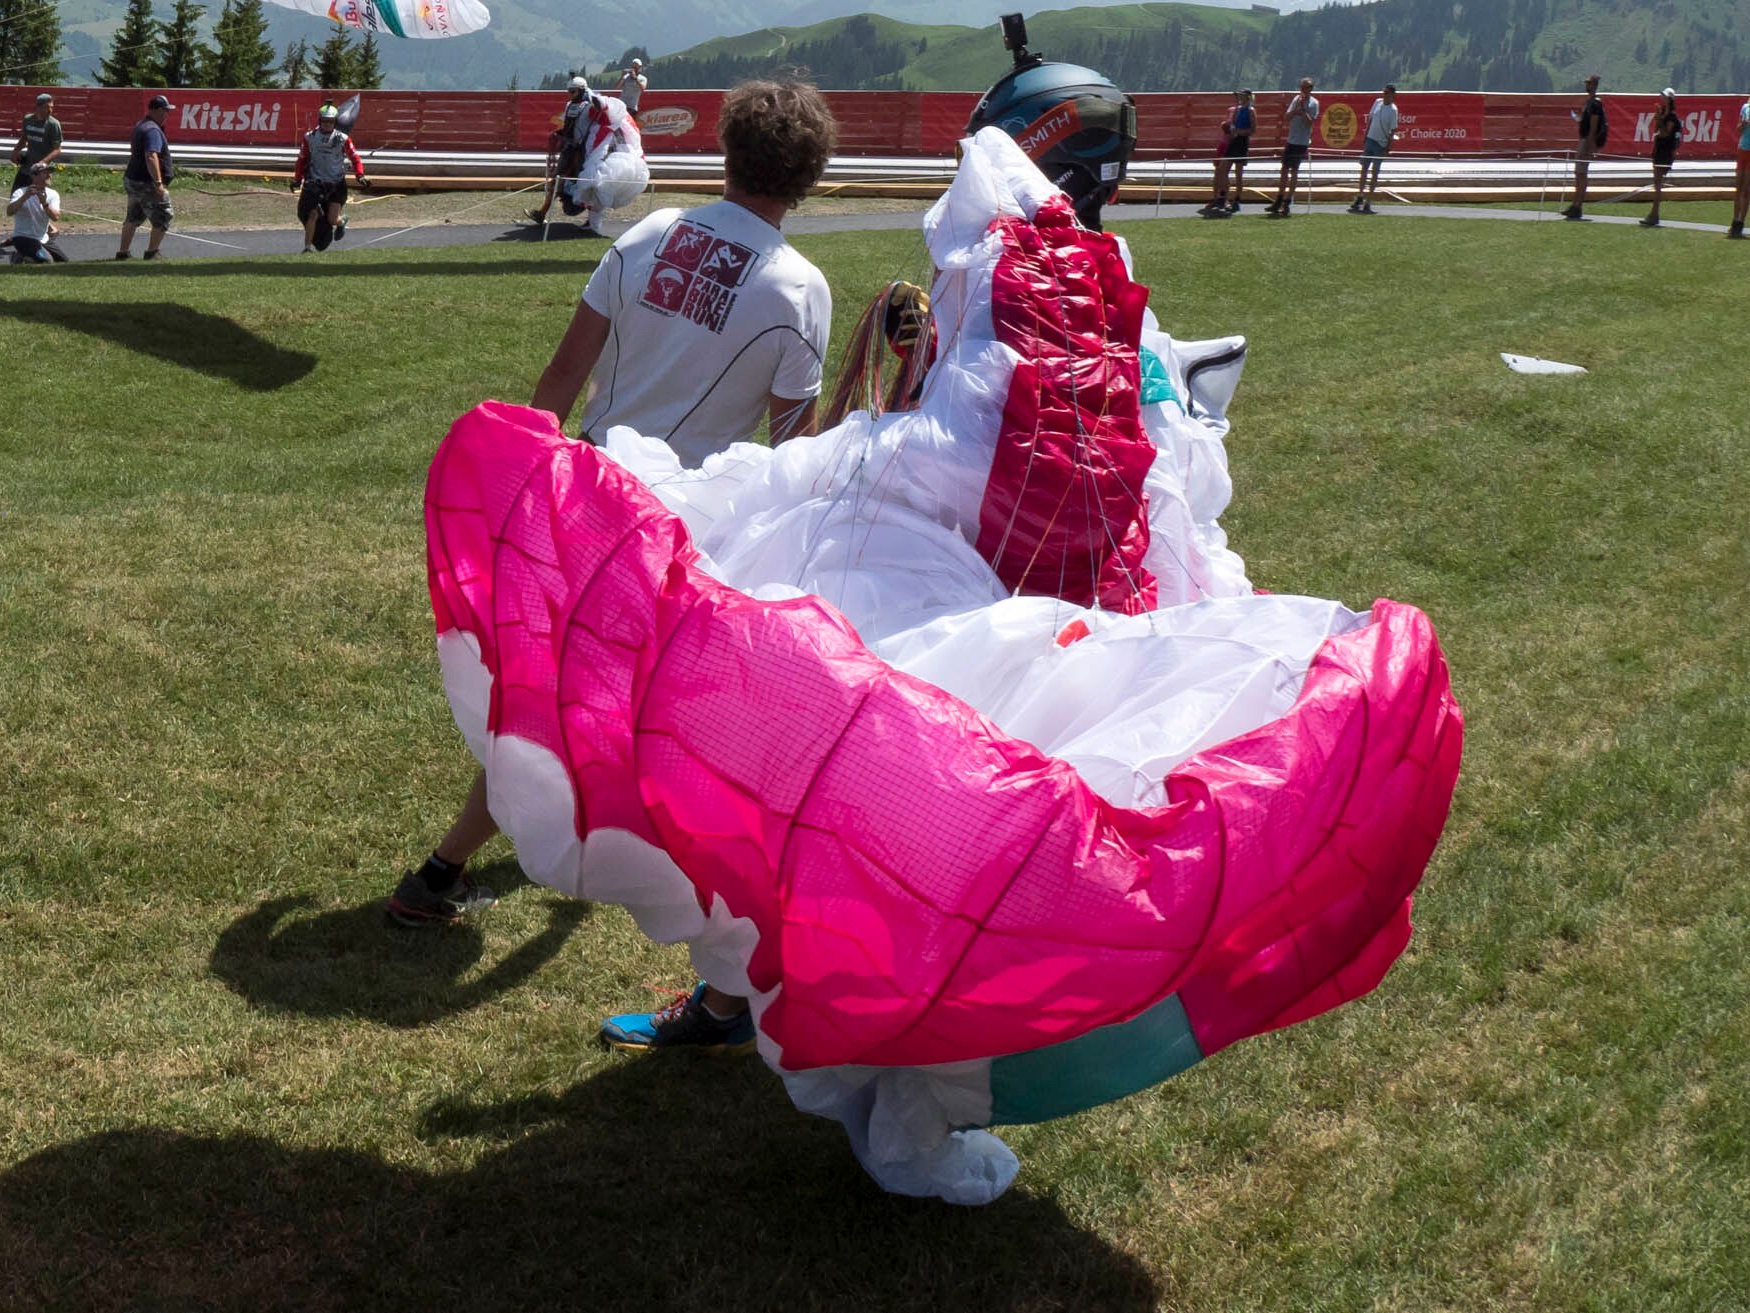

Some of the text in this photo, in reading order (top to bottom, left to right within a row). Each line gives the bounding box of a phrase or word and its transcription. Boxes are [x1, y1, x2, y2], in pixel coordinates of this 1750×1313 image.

[180, 102, 281, 131] KitzSki
[645, 111, 690, 124] kiarea
[1633, 110, 1722, 143] KSki
[1019, 111, 1071, 154] SMITH
[1410, 128, 1444, 139] Choice
[1444, 128, 1466, 139] 2020
